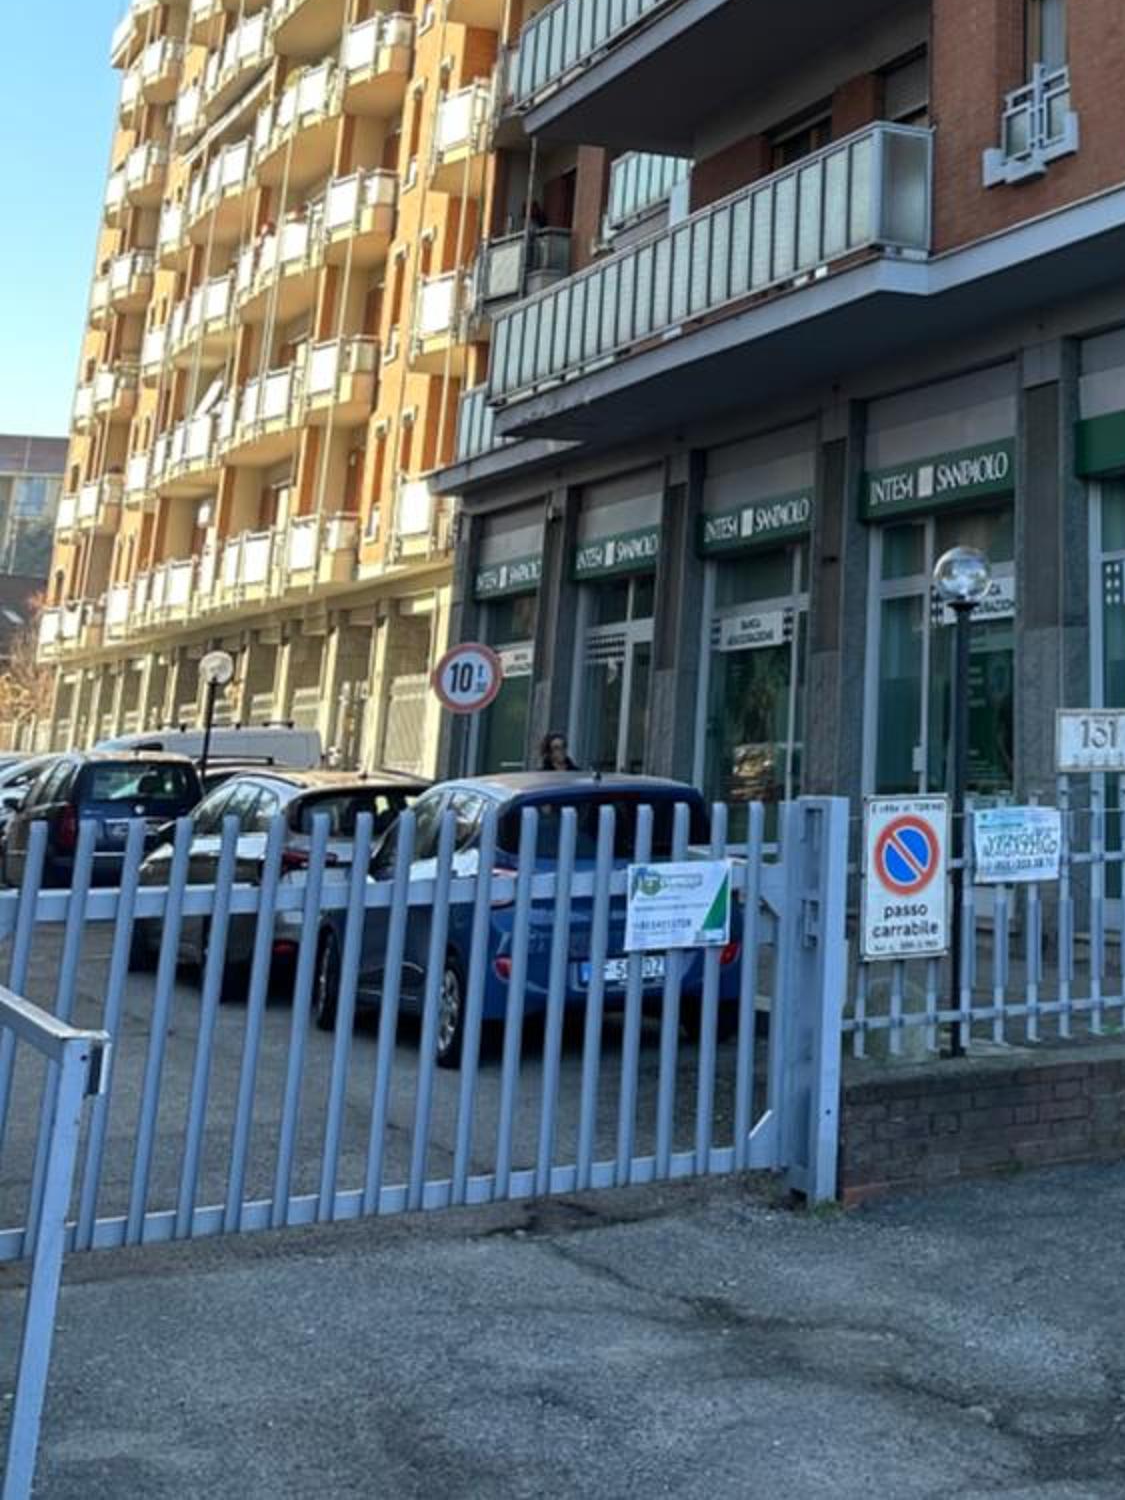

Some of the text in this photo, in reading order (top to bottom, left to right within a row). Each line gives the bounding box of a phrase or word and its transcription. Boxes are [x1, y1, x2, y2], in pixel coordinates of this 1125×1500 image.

[869, 451, 1009, 506] INTESA SANPAOLO
[450, 662, 474, 693] 10
[883, 903, 928, 920] passo
[872, 922, 939, 940] carrabile
